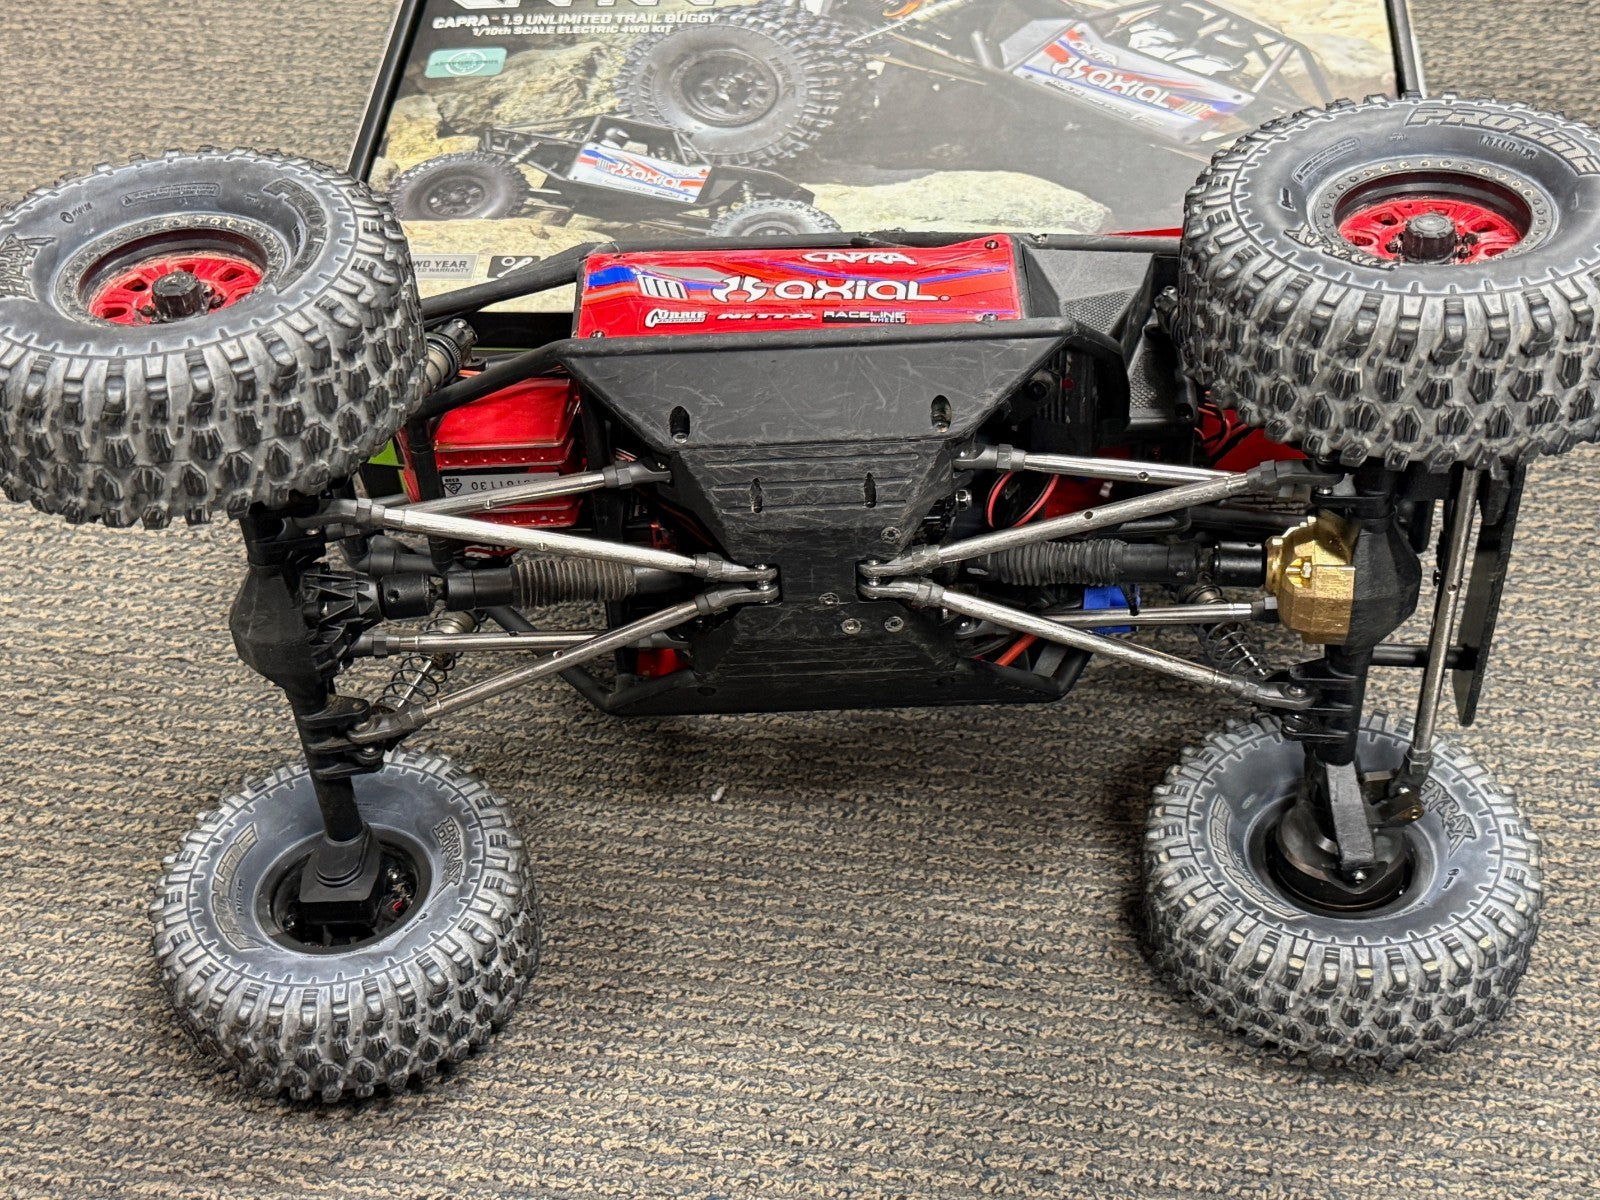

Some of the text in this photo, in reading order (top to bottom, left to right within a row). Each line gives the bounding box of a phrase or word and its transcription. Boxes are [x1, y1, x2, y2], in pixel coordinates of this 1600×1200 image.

[432, 12, 719, 29] CAPRA 1.9 UNLIMITED TRAIL BUGGY
[472, 24, 674, 37] 1/10th SCALE ELECTRIC 4WD KIT
[411, 260, 468, 269] WO YEAR
[802, 252, 918, 265] CAPRA
[823, 311, 906, 319] RACELINE
